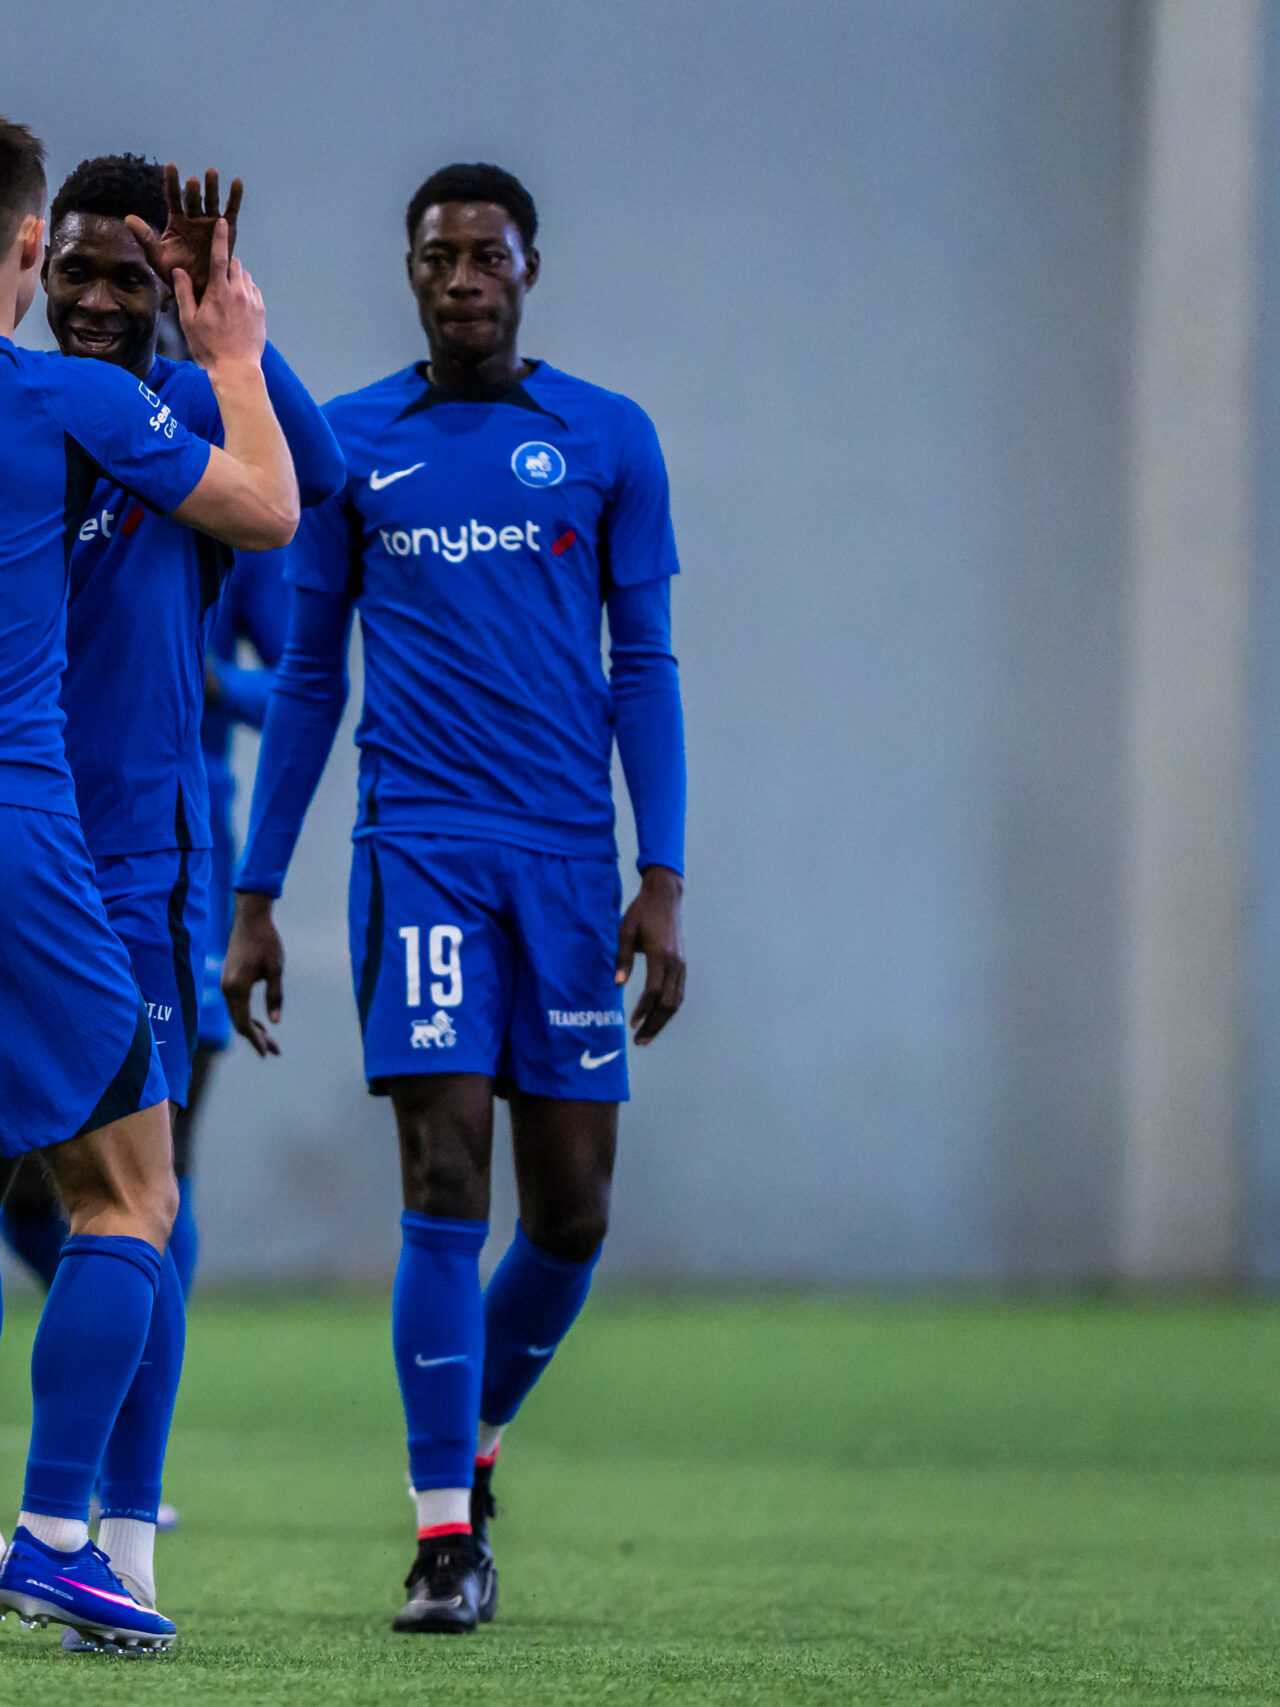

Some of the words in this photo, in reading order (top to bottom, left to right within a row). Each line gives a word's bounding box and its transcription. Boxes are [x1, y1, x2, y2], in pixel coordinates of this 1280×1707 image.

[379, 518, 541, 563] tonybet
[399, 924, 463, 1007] 19
[144, 1002, 173, 1022] T.LV
